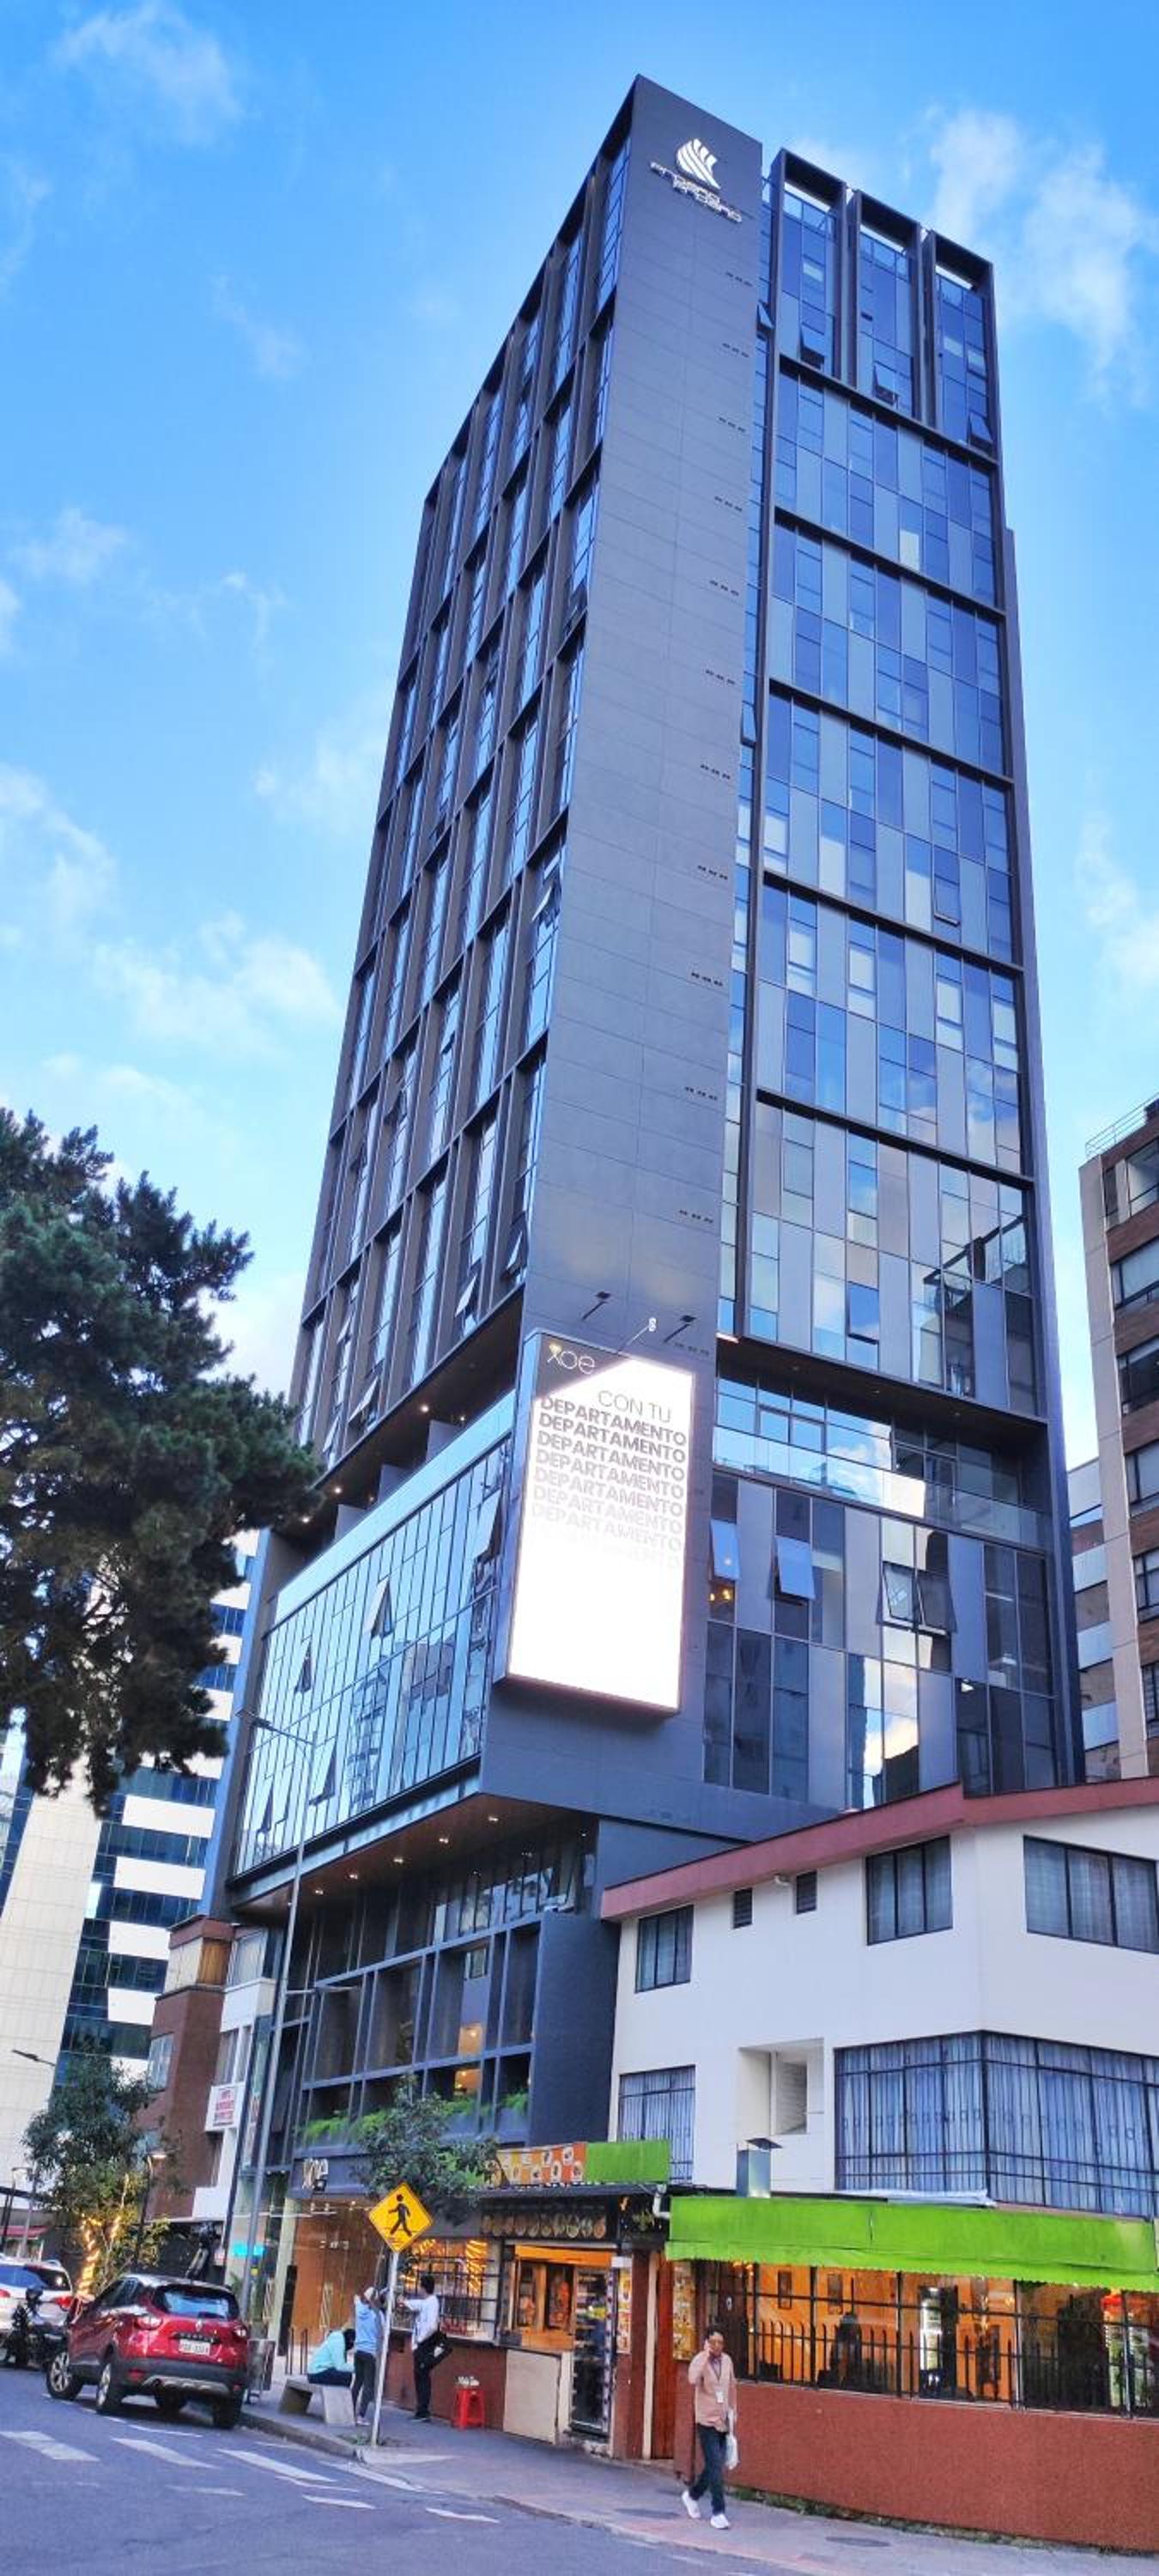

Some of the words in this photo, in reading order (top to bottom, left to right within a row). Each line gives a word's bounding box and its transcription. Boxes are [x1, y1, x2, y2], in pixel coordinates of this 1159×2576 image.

[541, 1396, 687, 1446] DEPARTAMENTO
[598, 1390, 643, 1416] CON
[648, 1402, 671, 1423] TU
[537, 1430, 685, 1480] DEPARTAMENTO
[538, 1413, 686, 1463] DEPARTAMENTO
[534, 1466, 683, 1517] DEPARTAMENTO
[536, 1448, 684, 1499] DEPARTAMENTO
[533, 1485, 683, 1534] DEPARTAMENTO
